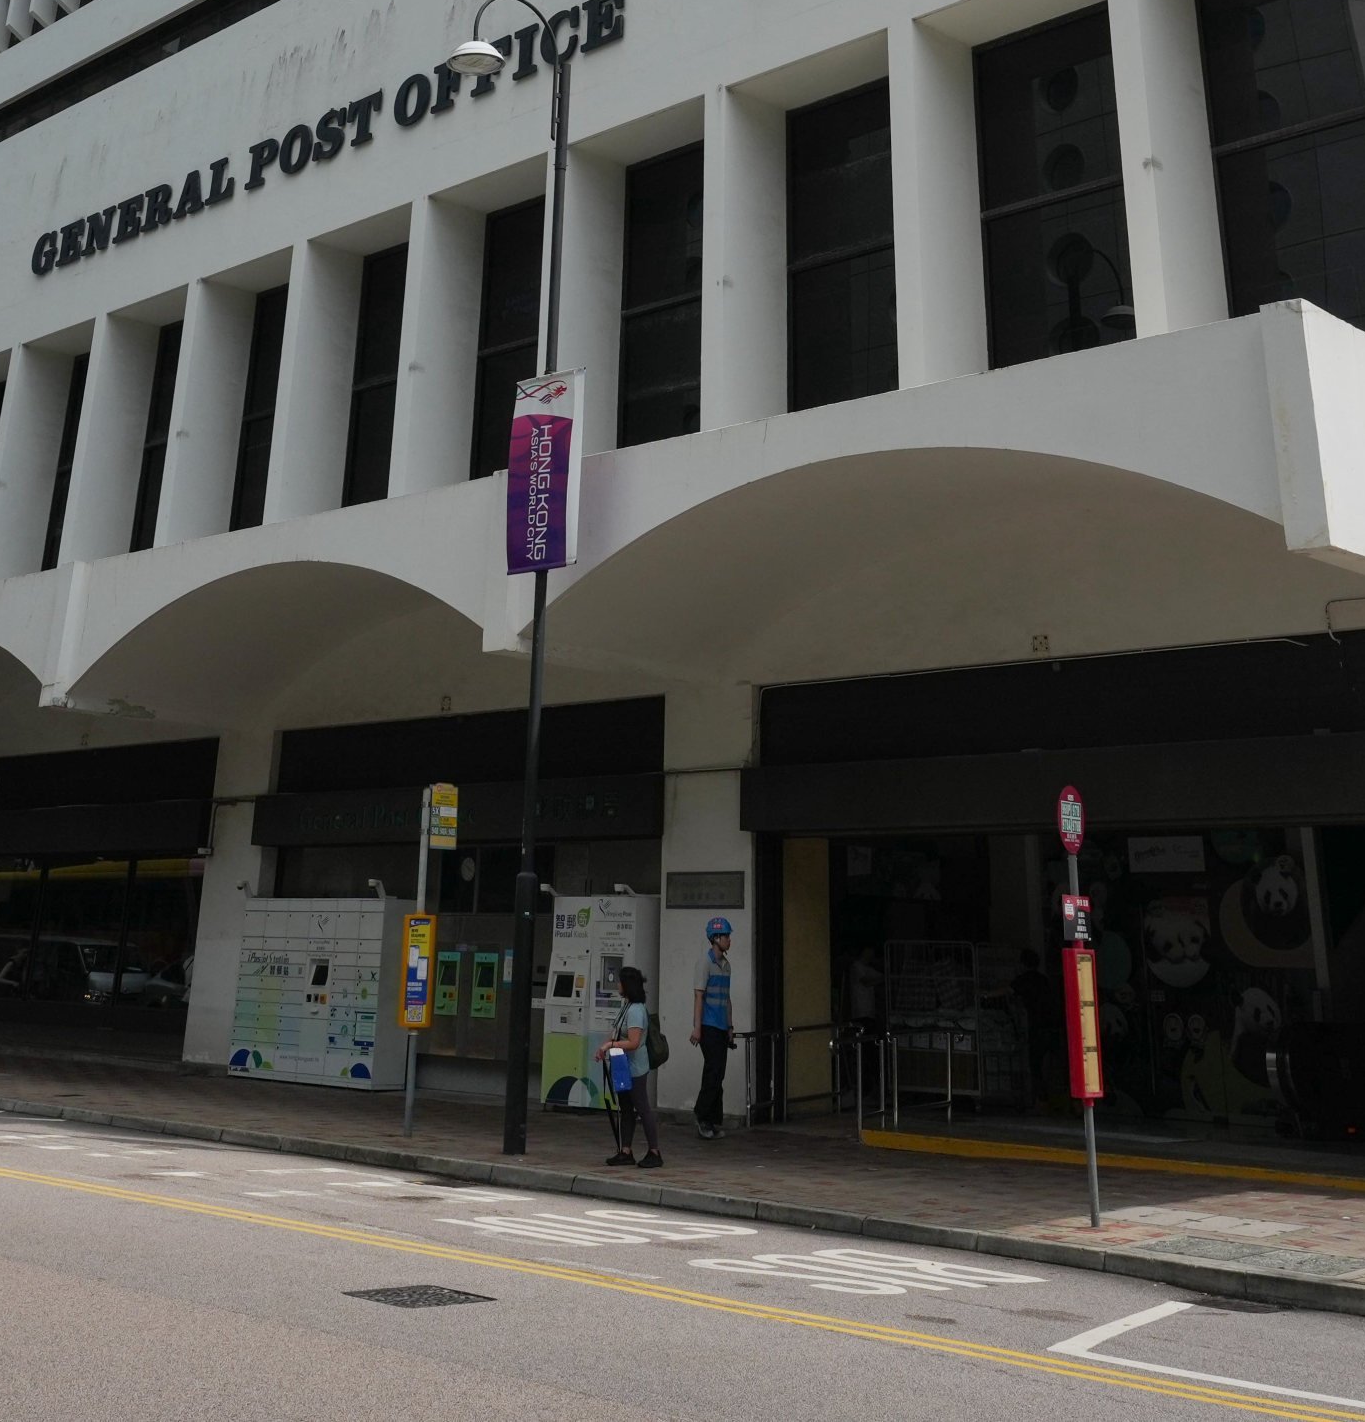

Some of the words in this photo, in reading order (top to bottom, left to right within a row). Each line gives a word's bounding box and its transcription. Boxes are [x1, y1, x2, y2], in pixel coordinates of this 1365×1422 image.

[31, 156, 235, 276] GENERAL
[243, 88, 383, 191] POST
[529, 427, 539, 475] ASIA'S
[537, 424, 552, 490] HONG
[527, 476, 537, 525] WORLD
[525, 527, 535, 560] CITY
[534, 492, 549, 560] KONG
[555, 930, 573, 938] iPostal
[434, 1209, 758, 1247] STOP
[687, 1248, 1050, 1295] BUS
